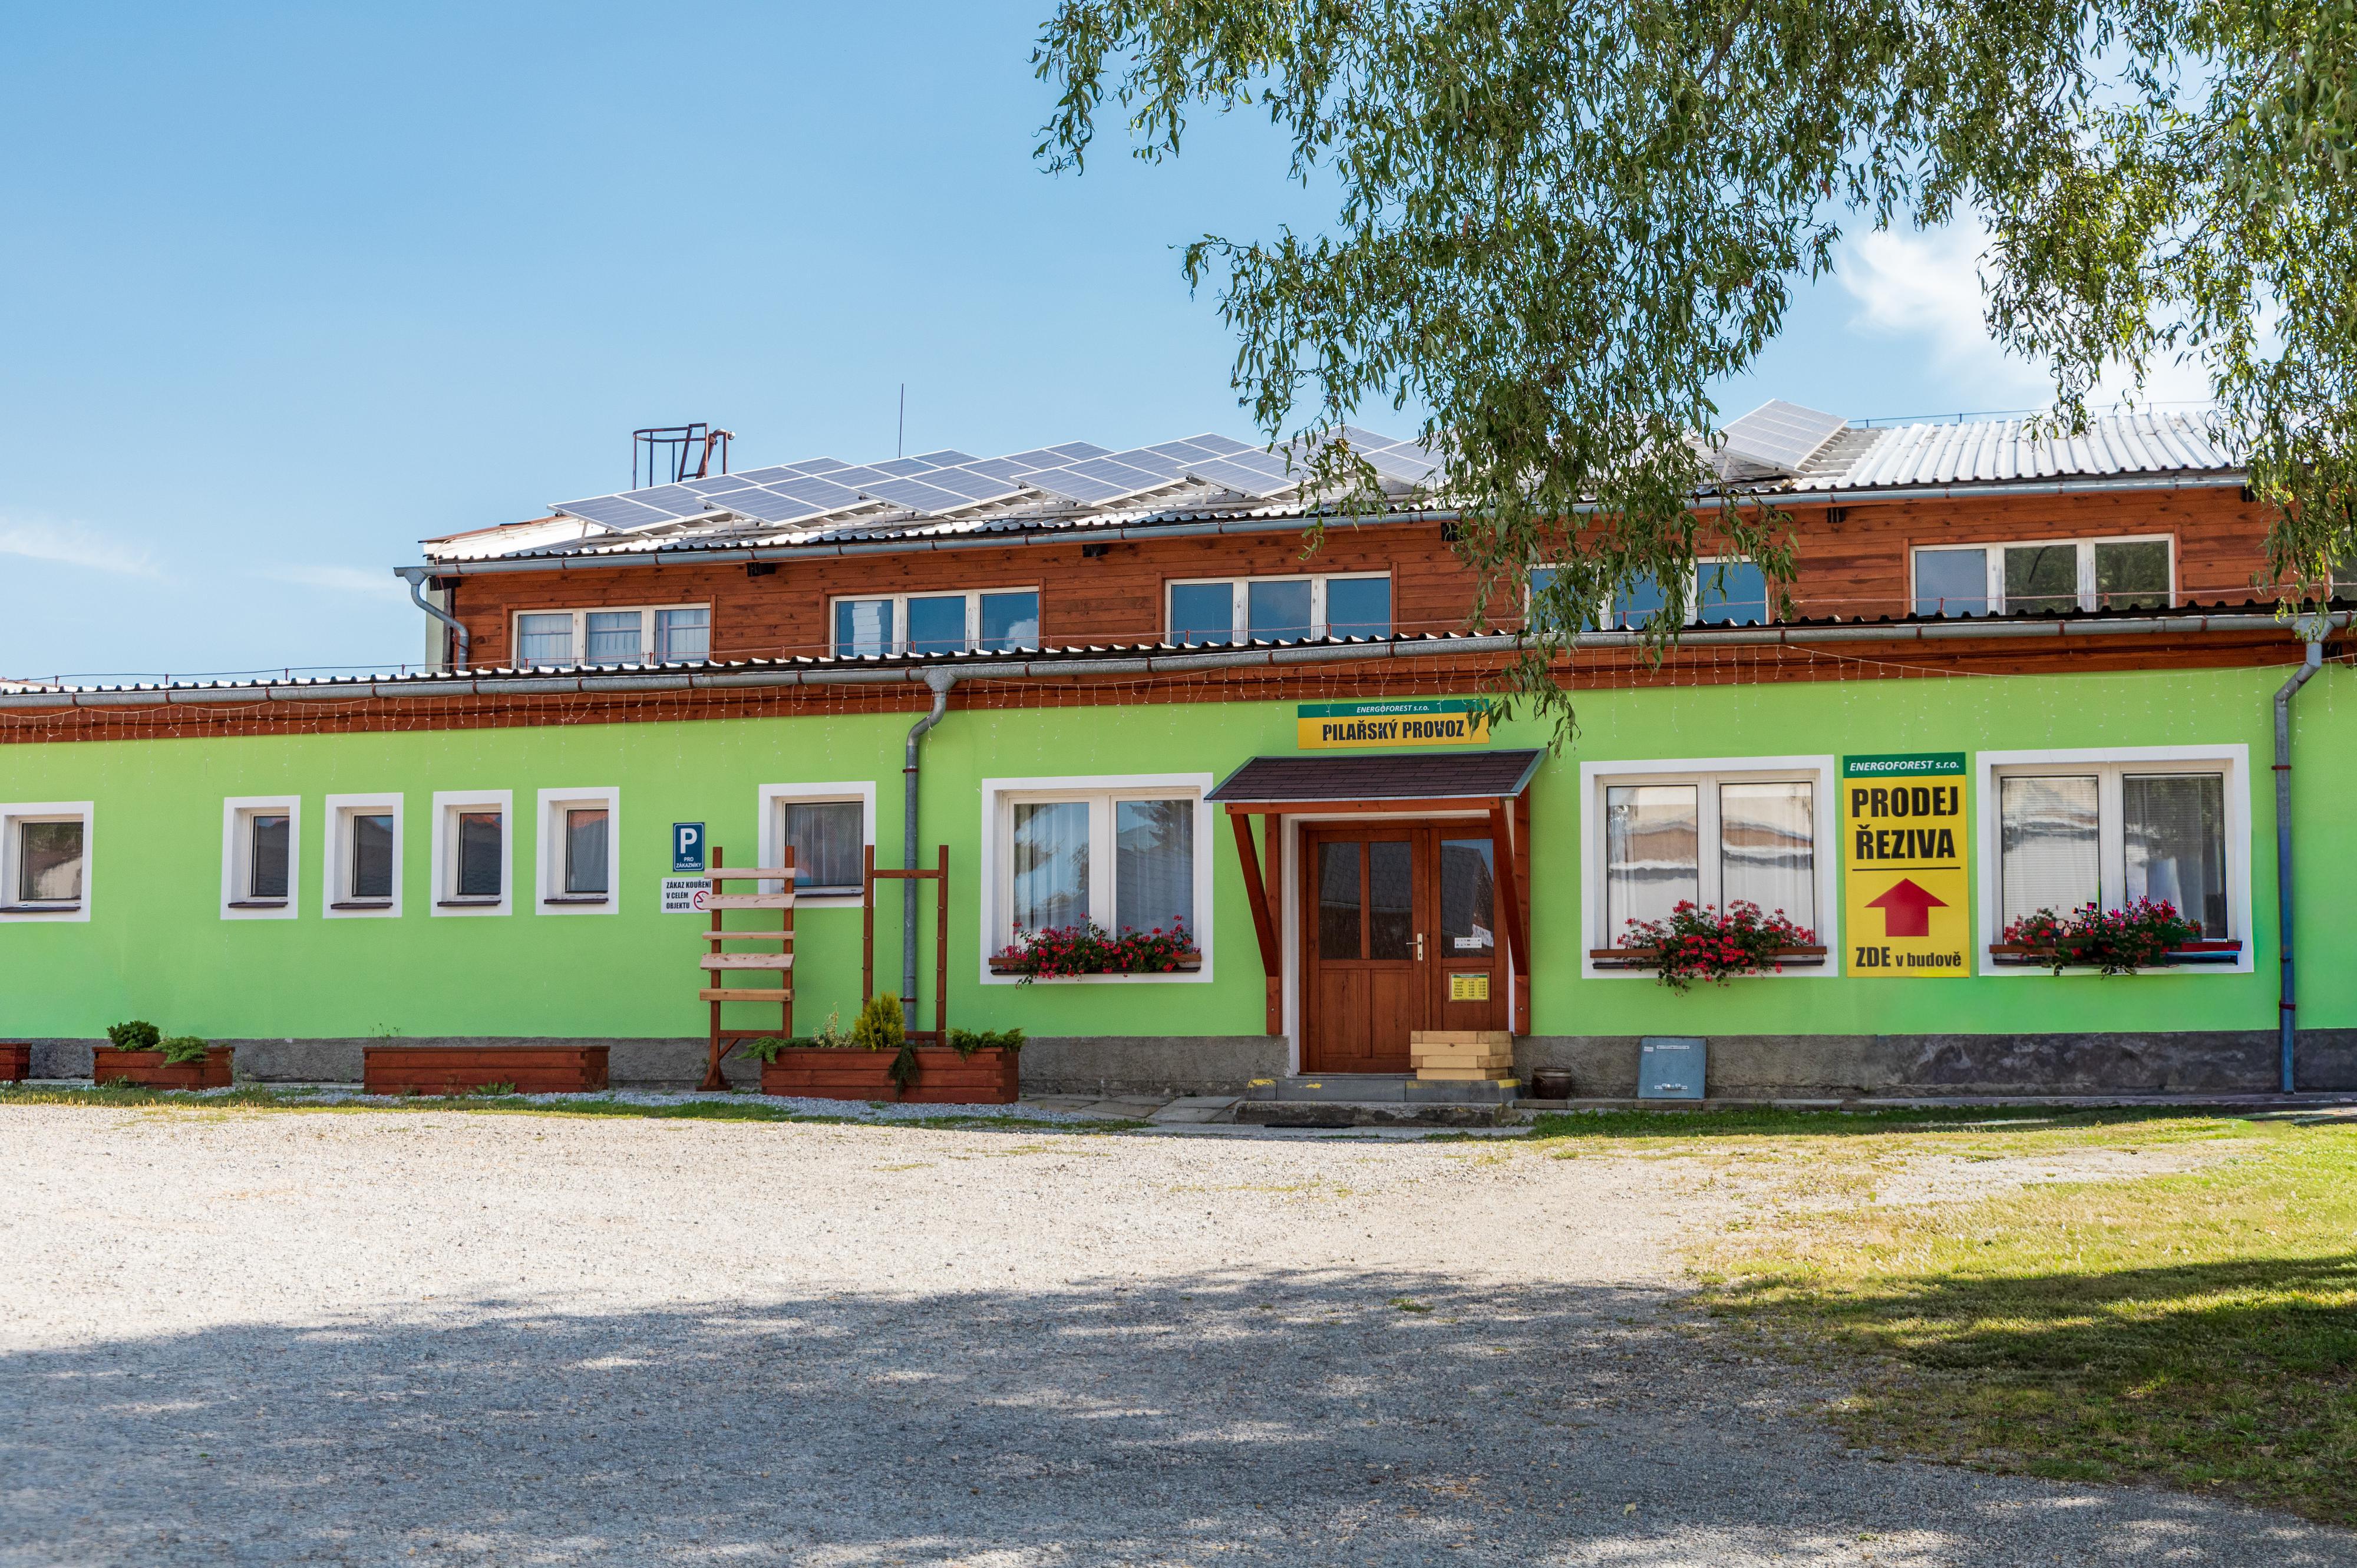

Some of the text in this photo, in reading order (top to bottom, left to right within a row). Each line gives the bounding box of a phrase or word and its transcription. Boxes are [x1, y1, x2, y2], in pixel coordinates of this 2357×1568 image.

[1356, 705, 1412, 713] ENERGOFOREST
[1322, 719, 1464, 741] PILAŘSKÝ PROVOZ
[1850, 760, 1959, 771] ENERGOFOREST s.r.o.
[1851, 786, 1959, 818] PRODEJ
[680, 828, 698, 854] P
[1856, 824, 1956, 860] ŘEZIVA
[666, 880, 711, 889] ZÁKAZ KOUŘENÍ
[1856, 946, 1962, 968] ZDE v budově
